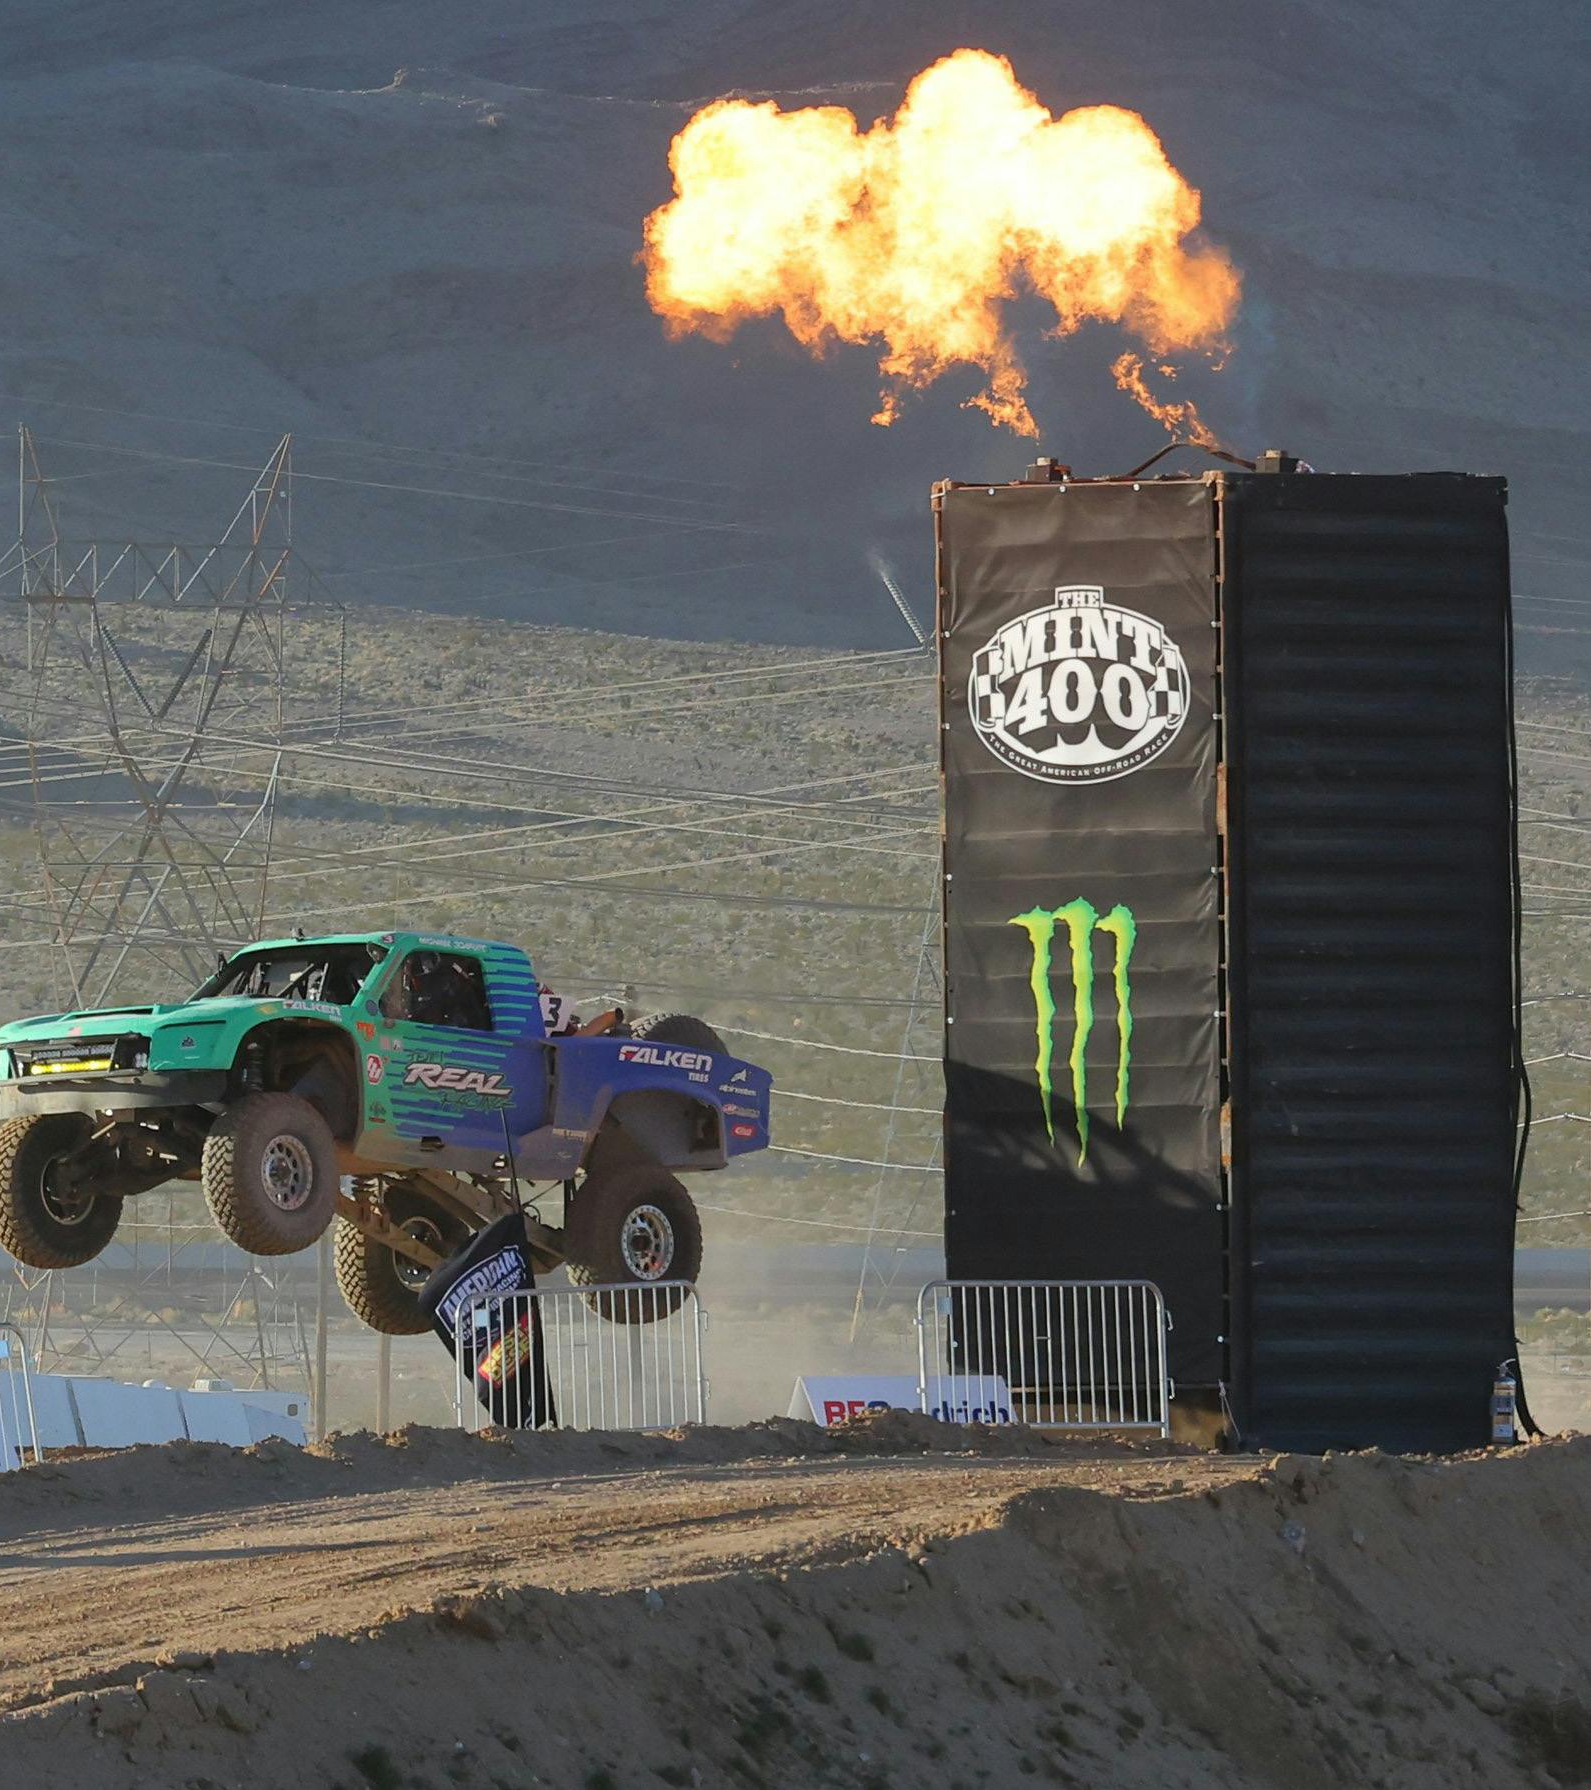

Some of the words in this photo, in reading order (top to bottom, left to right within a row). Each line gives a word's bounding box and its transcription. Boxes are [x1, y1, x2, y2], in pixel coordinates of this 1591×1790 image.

[1059, 592, 1100, 608] THE
[999, 608, 1161, 684] MINT
[1004, 659, 1152, 735] 400
[989, 734, 1005, 753] THE
[1009, 751, 1038, 770] GREAT
[1040, 766, 1090, 777] AMERICAN
[1093, 755, 1141, 775] OFF-ROAD
[1143, 734, 1168, 756] RACE
[544, 997, 562, 1028] 3
[619, 1045, 713, 1072] FALKEN
[404, 1063, 513, 1096] REAL
[689, 1072, 709, 1084] TIRES
